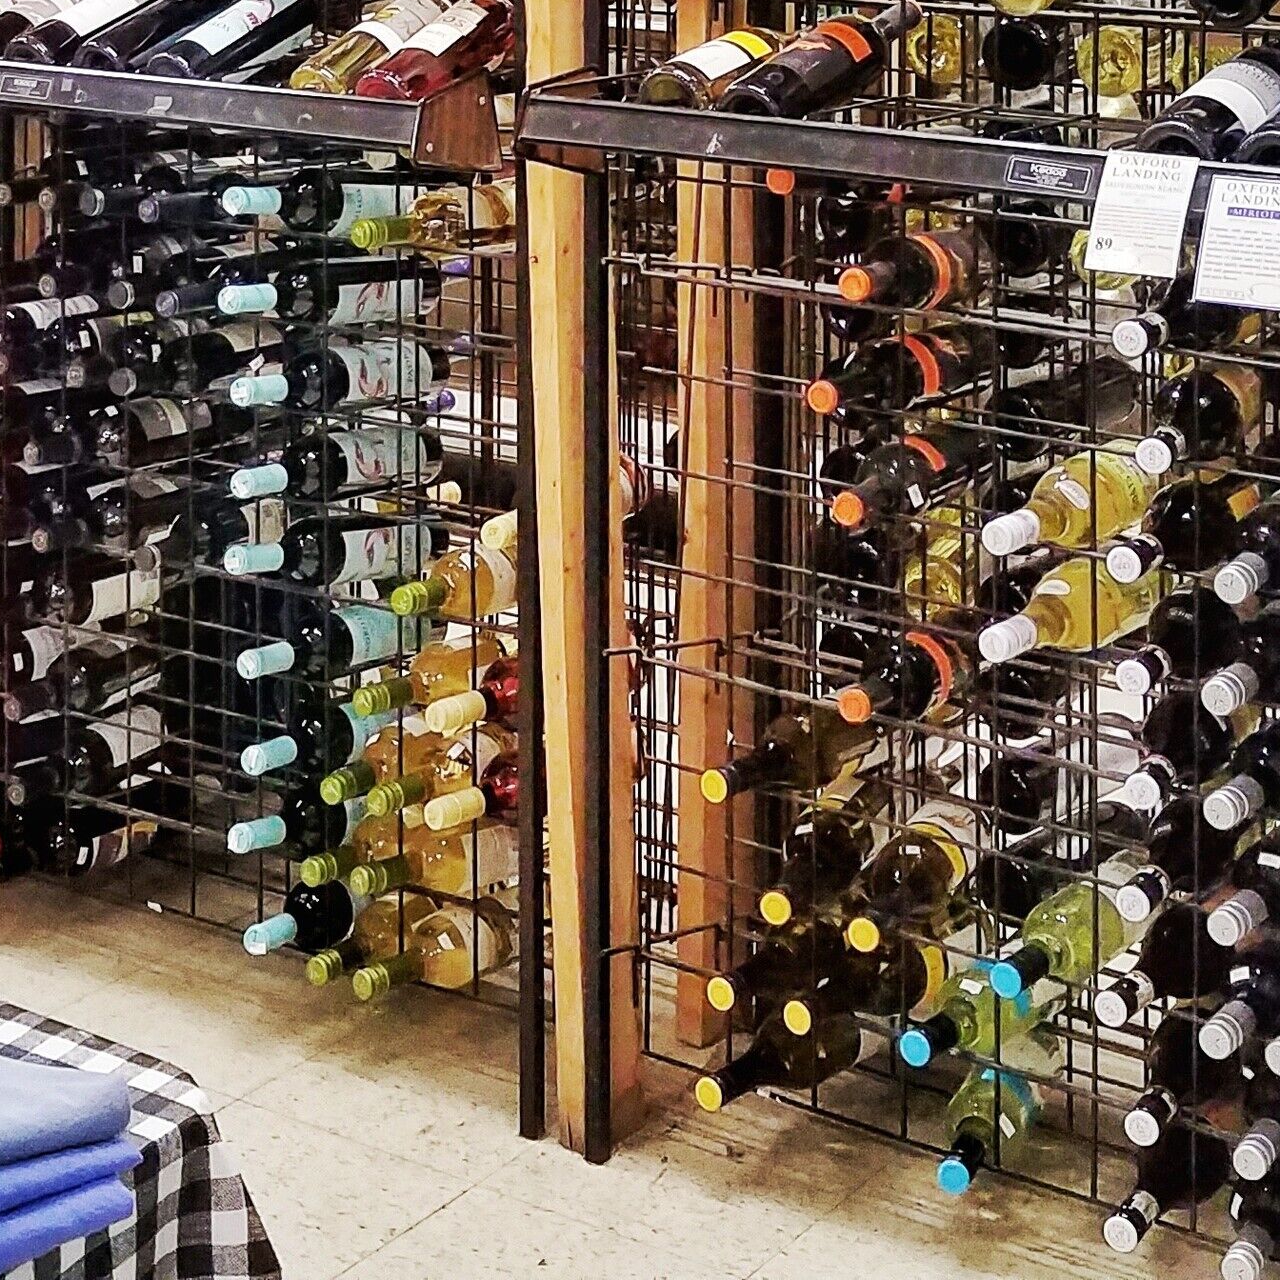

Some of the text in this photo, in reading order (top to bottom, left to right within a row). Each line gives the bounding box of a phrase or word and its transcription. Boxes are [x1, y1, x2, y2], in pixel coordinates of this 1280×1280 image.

[1120, 155, 1182, 170] OXFORD
[1112, 167, 1182, 182] LANDING
[1095, 236, 1113, 251] 89
